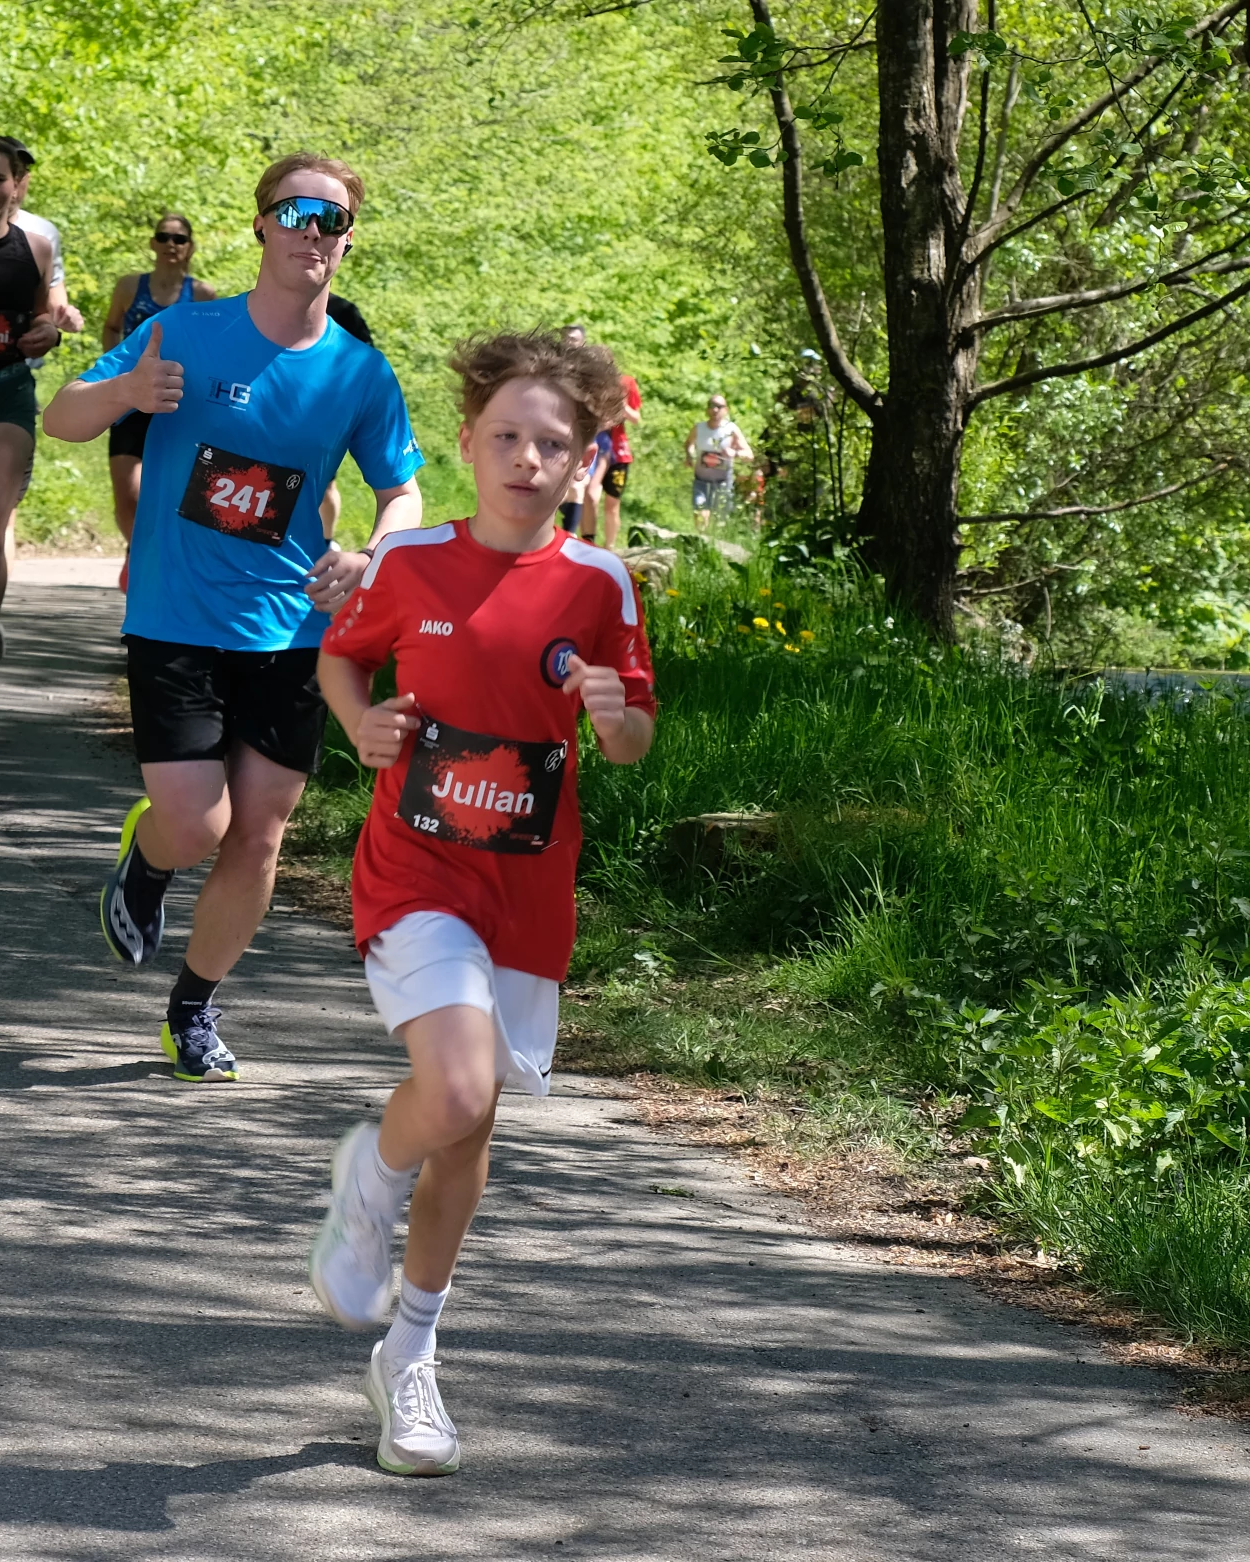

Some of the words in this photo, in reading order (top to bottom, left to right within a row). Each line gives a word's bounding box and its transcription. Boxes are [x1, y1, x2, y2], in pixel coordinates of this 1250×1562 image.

[210, 477, 271, 518] 241
[418, 619, 454, 636] JAKO
[431, 771, 535, 814] Julian
[413, 814, 440, 833] 132
